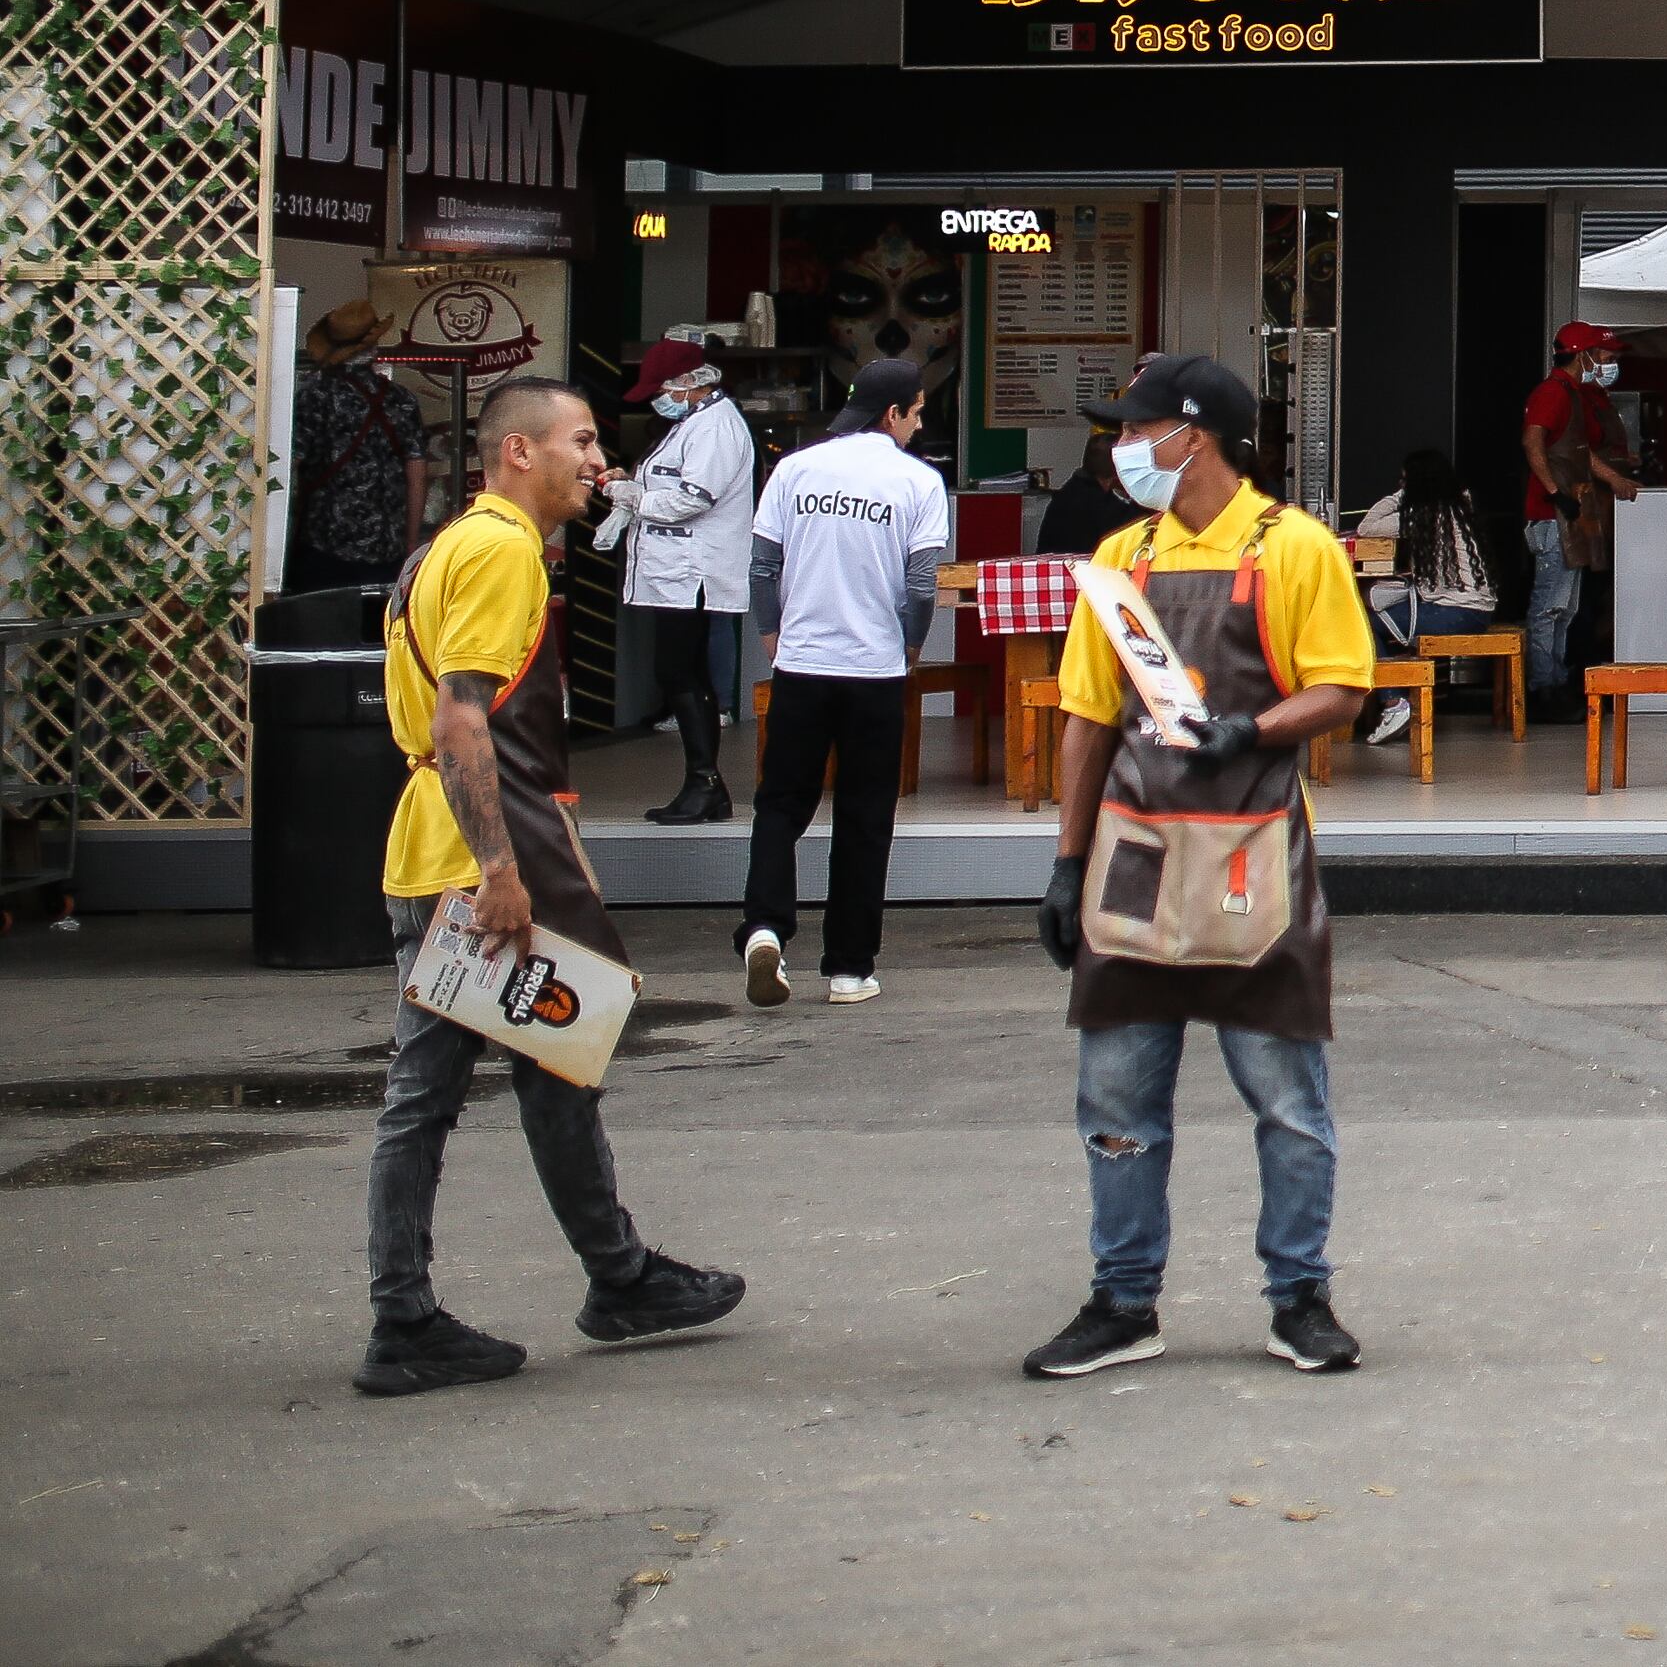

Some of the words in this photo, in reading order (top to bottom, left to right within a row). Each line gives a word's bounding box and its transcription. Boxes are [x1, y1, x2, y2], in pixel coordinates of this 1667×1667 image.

[1111, 14, 1210, 52] fast
[1218, 13, 1335, 51] food
[406, 70, 588, 190] JIMMY
[288, 193, 312, 216] 313
[315, 197, 339, 219] 412
[342, 202, 371, 223] 3497
[941, 209, 1040, 234] ENTREGA
[475, 346, 526, 367] JIMMY
[796, 491, 892, 526] LOGÍSTICA
[512, 961, 549, 1019] BRUTAL
